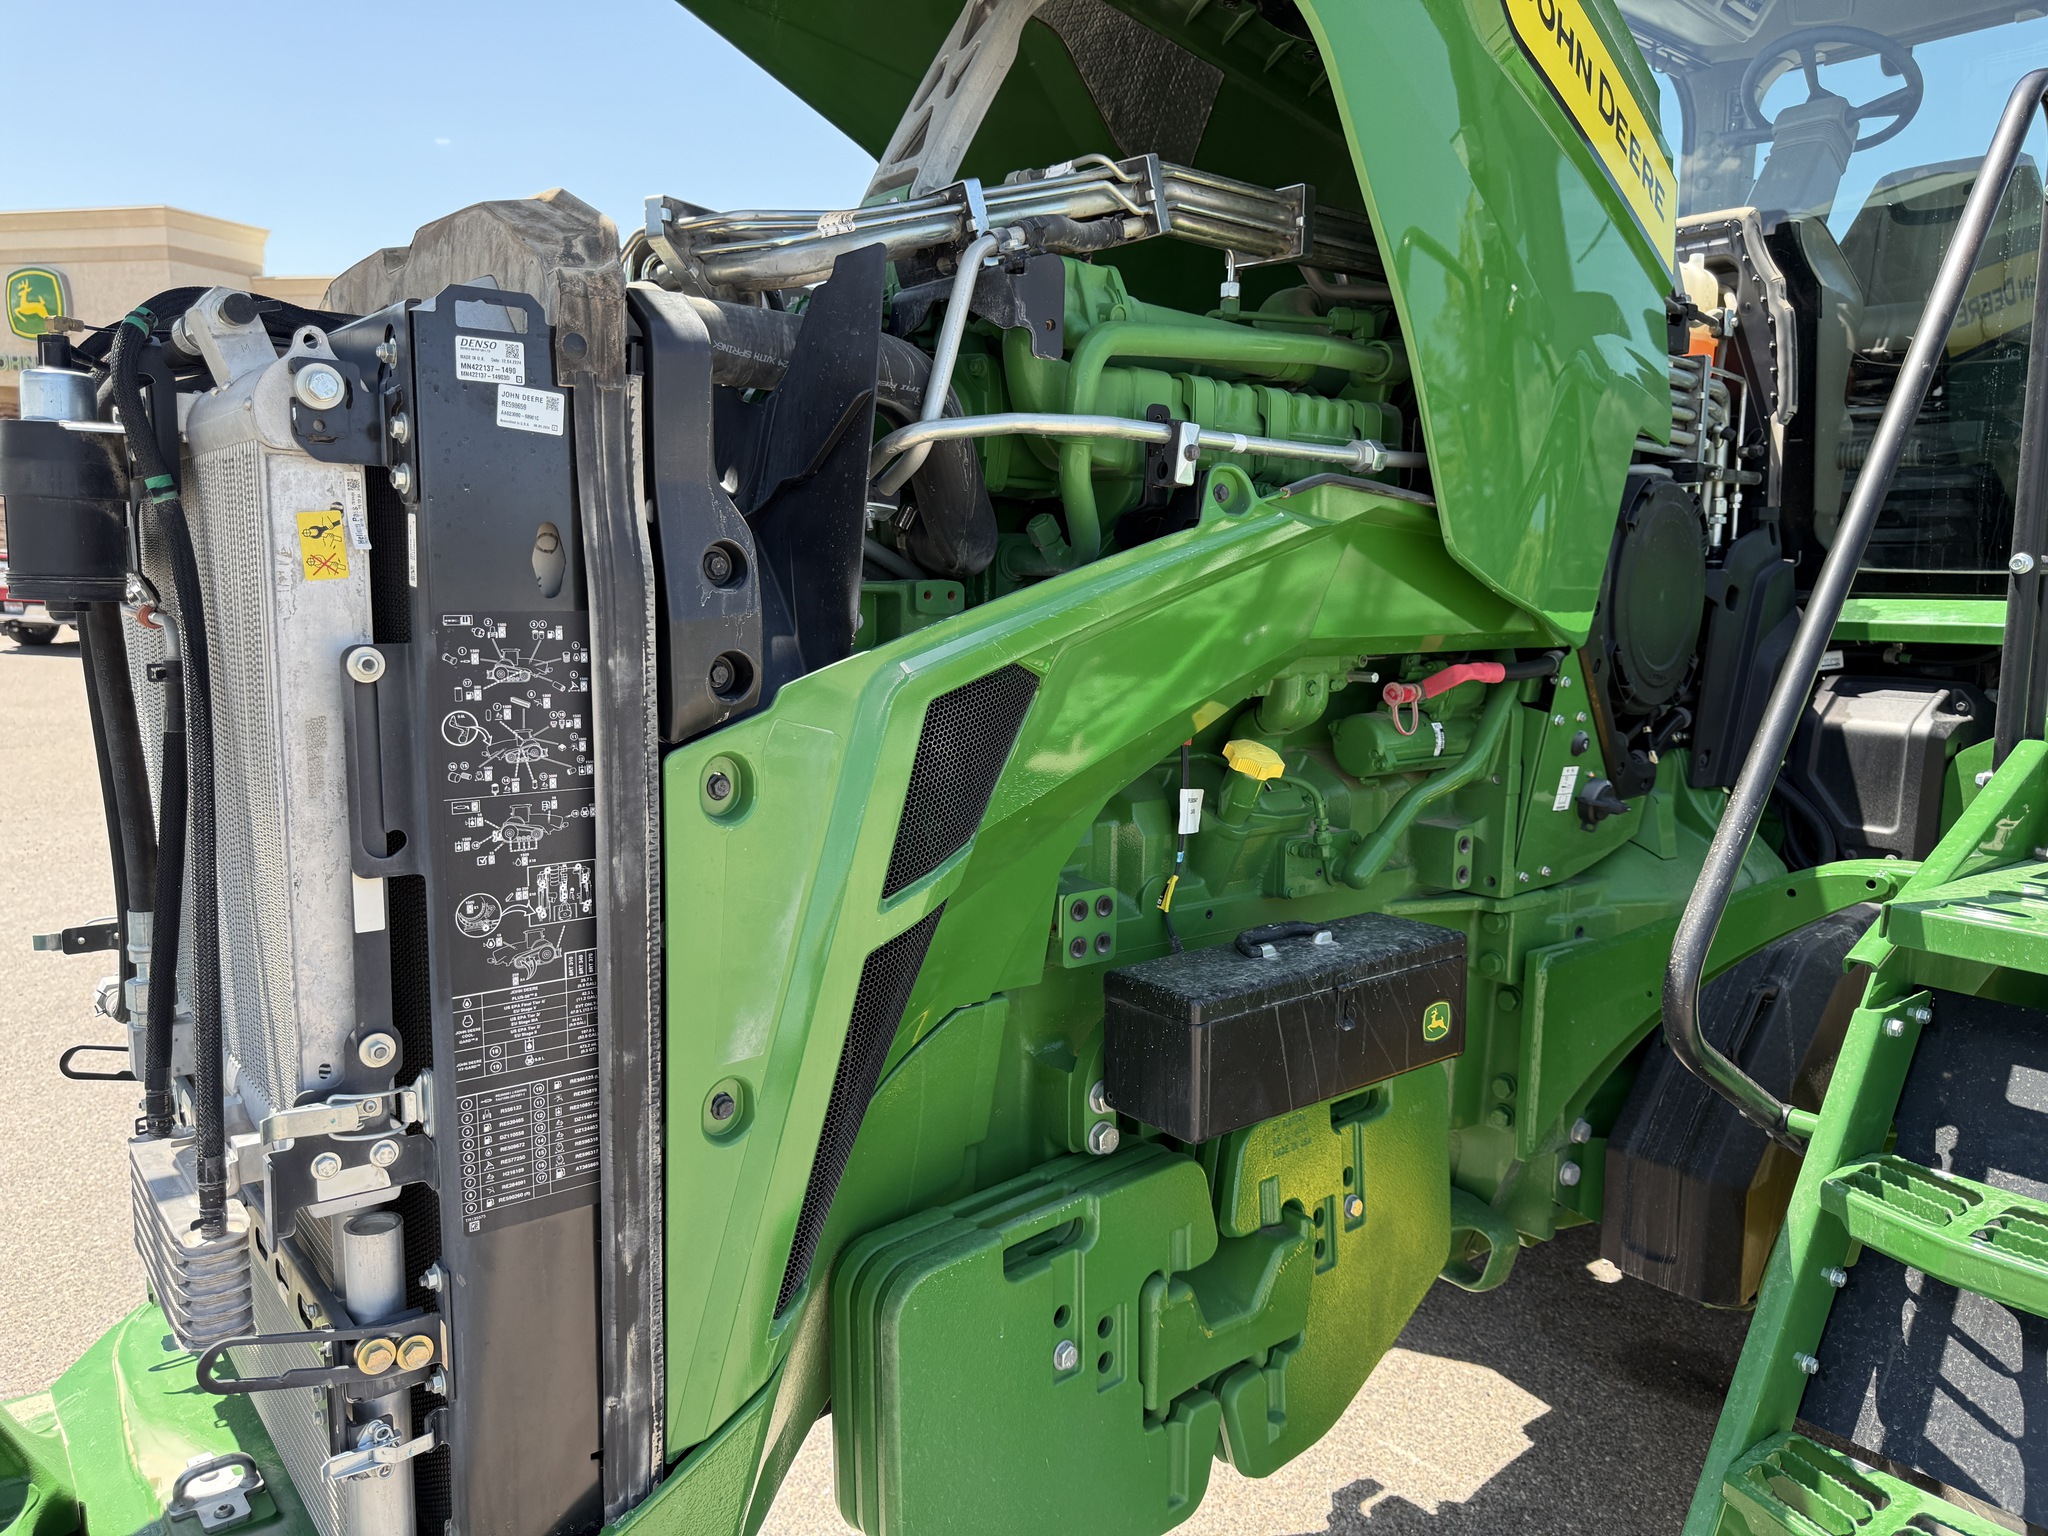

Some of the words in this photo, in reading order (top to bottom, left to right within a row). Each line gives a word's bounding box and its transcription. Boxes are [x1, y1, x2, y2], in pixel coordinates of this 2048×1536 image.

[1528, 0, 1593, 96] OHN
[1598, 68, 1666, 223] DEERE
[460, 338, 497, 349] DENSO
[502, 391, 520, 399] JOHN
[522, 394, 543, 404] DEERE
